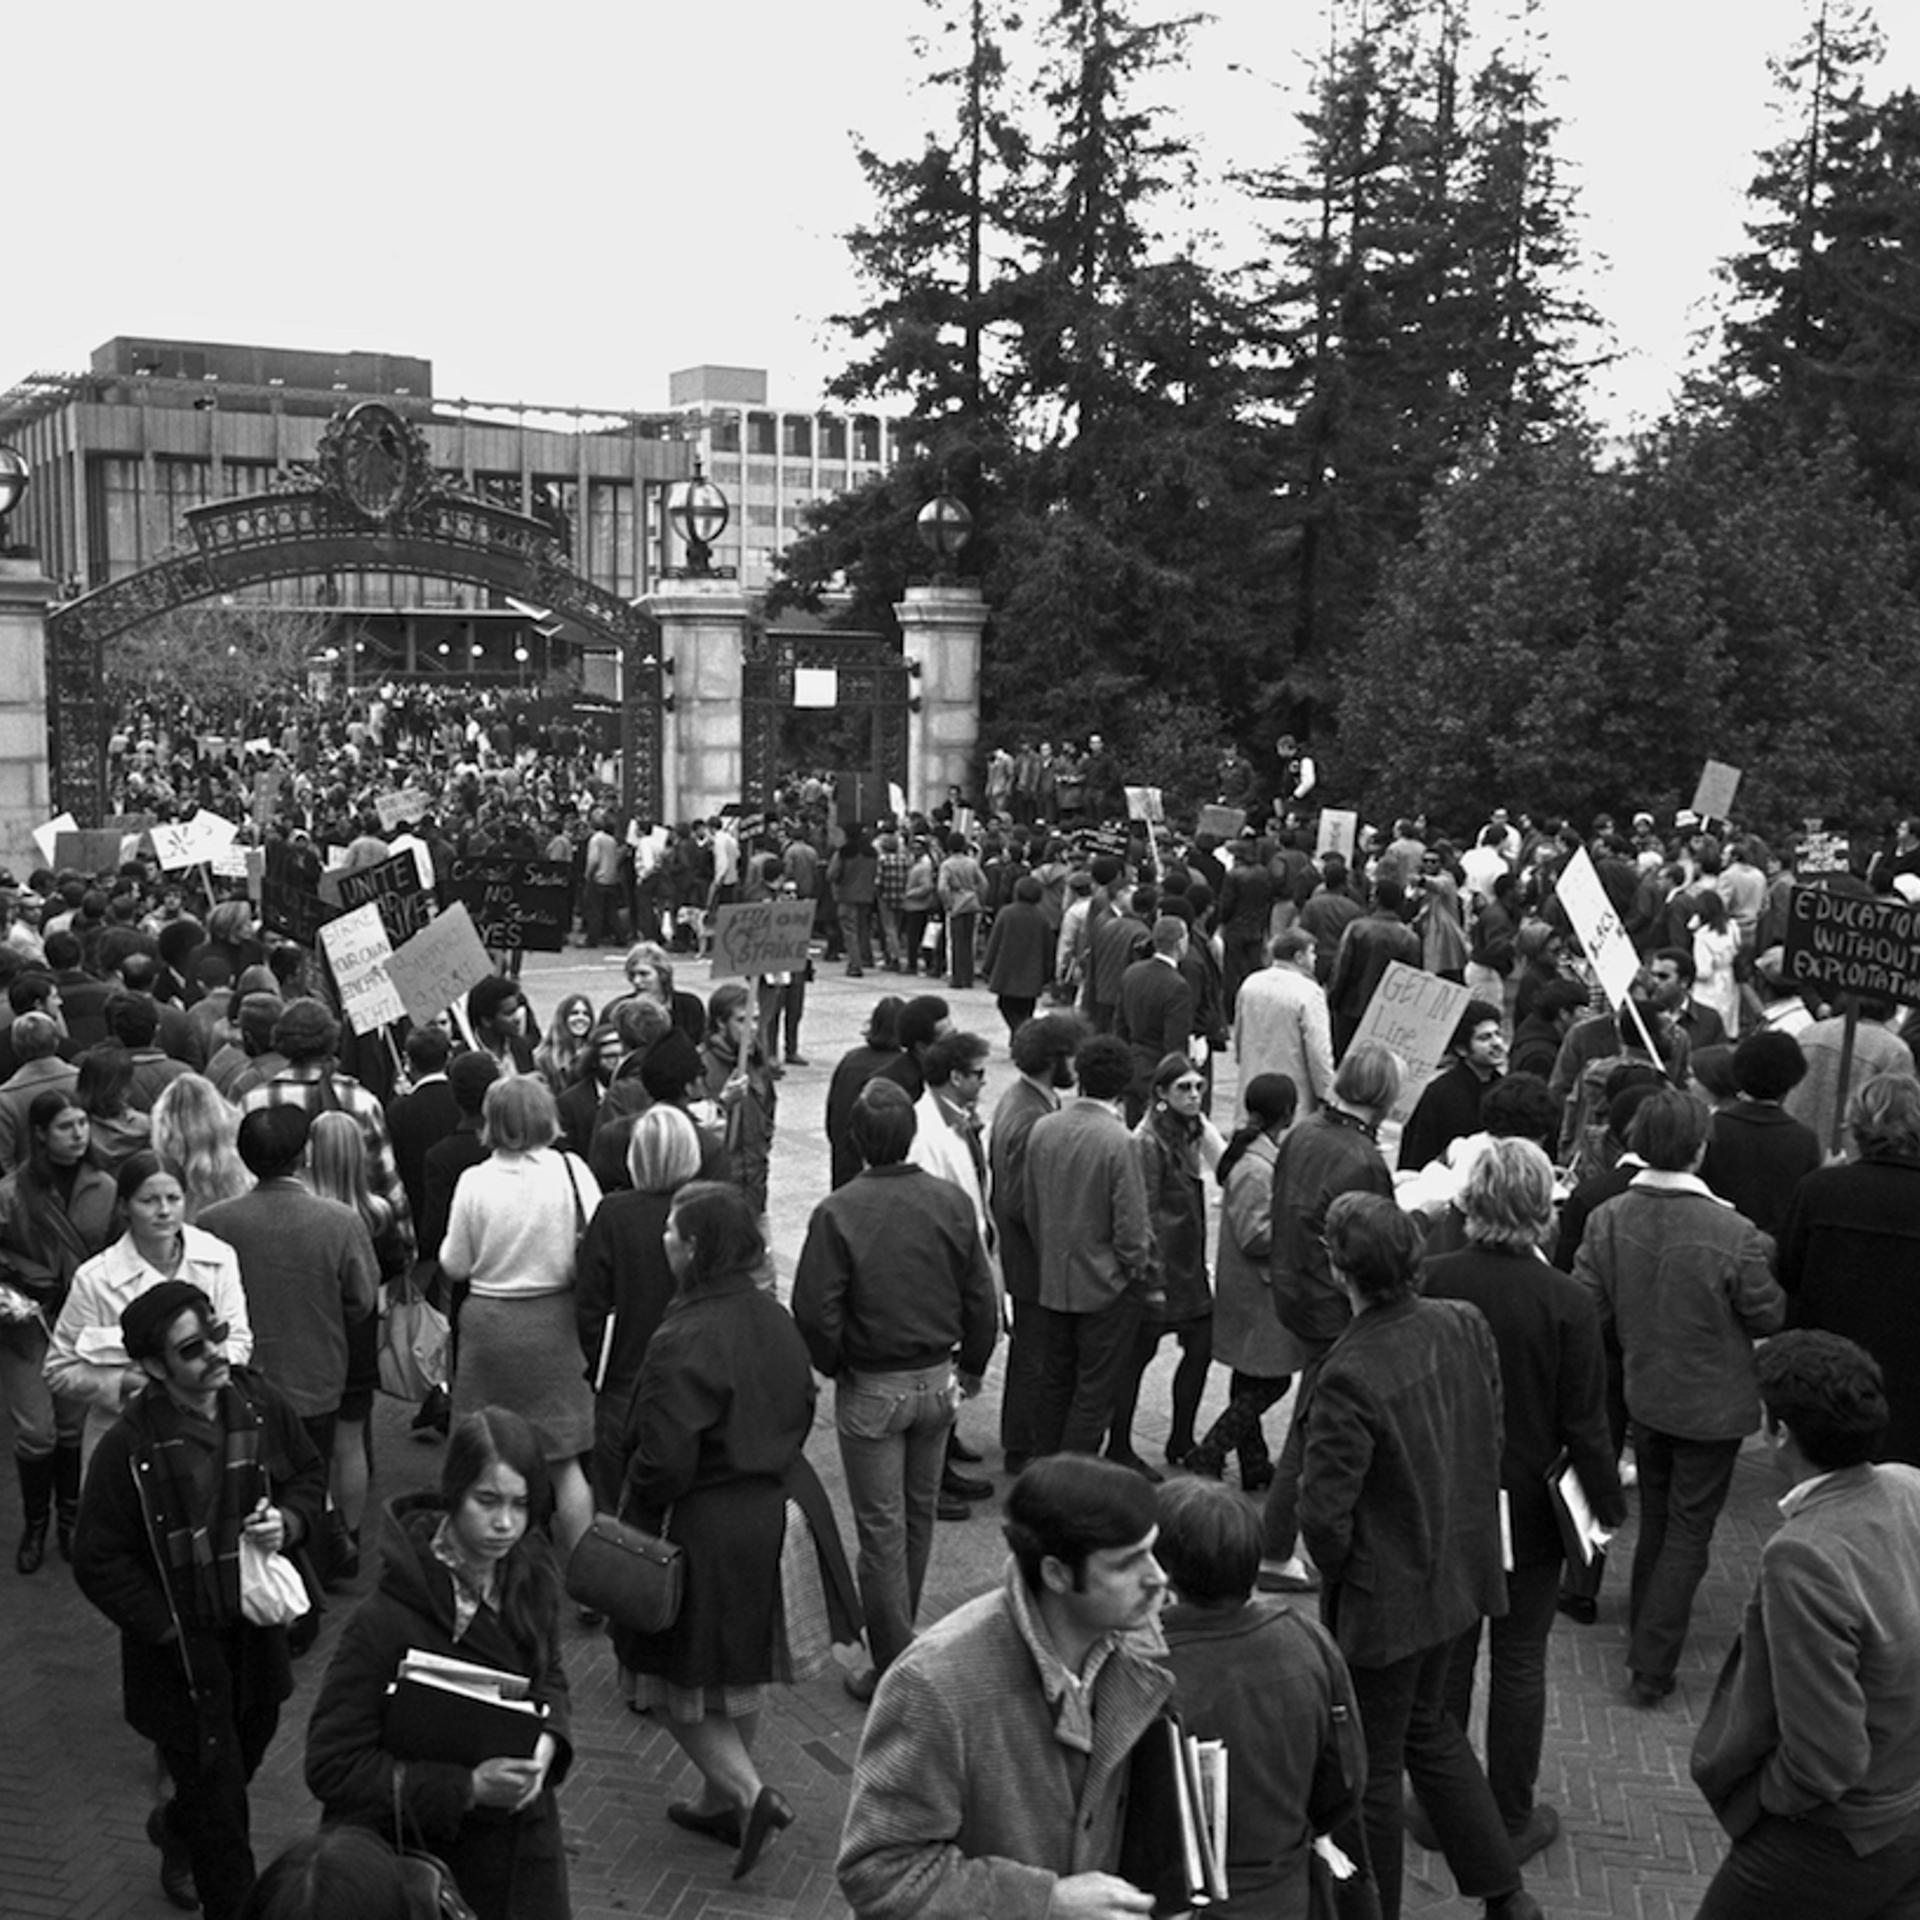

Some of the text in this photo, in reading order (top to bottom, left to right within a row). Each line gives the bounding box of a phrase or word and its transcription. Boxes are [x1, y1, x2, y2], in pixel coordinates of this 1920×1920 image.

[342, 855, 410, 905] UNITE
[484, 885, 514, 903] NO
[479, 922, 522, 947] YES
[776, 912, 811, 927] ON
[1812, 923, 1920, 973] WITHOUT
[1382, 966, 1434, 1007] GET
